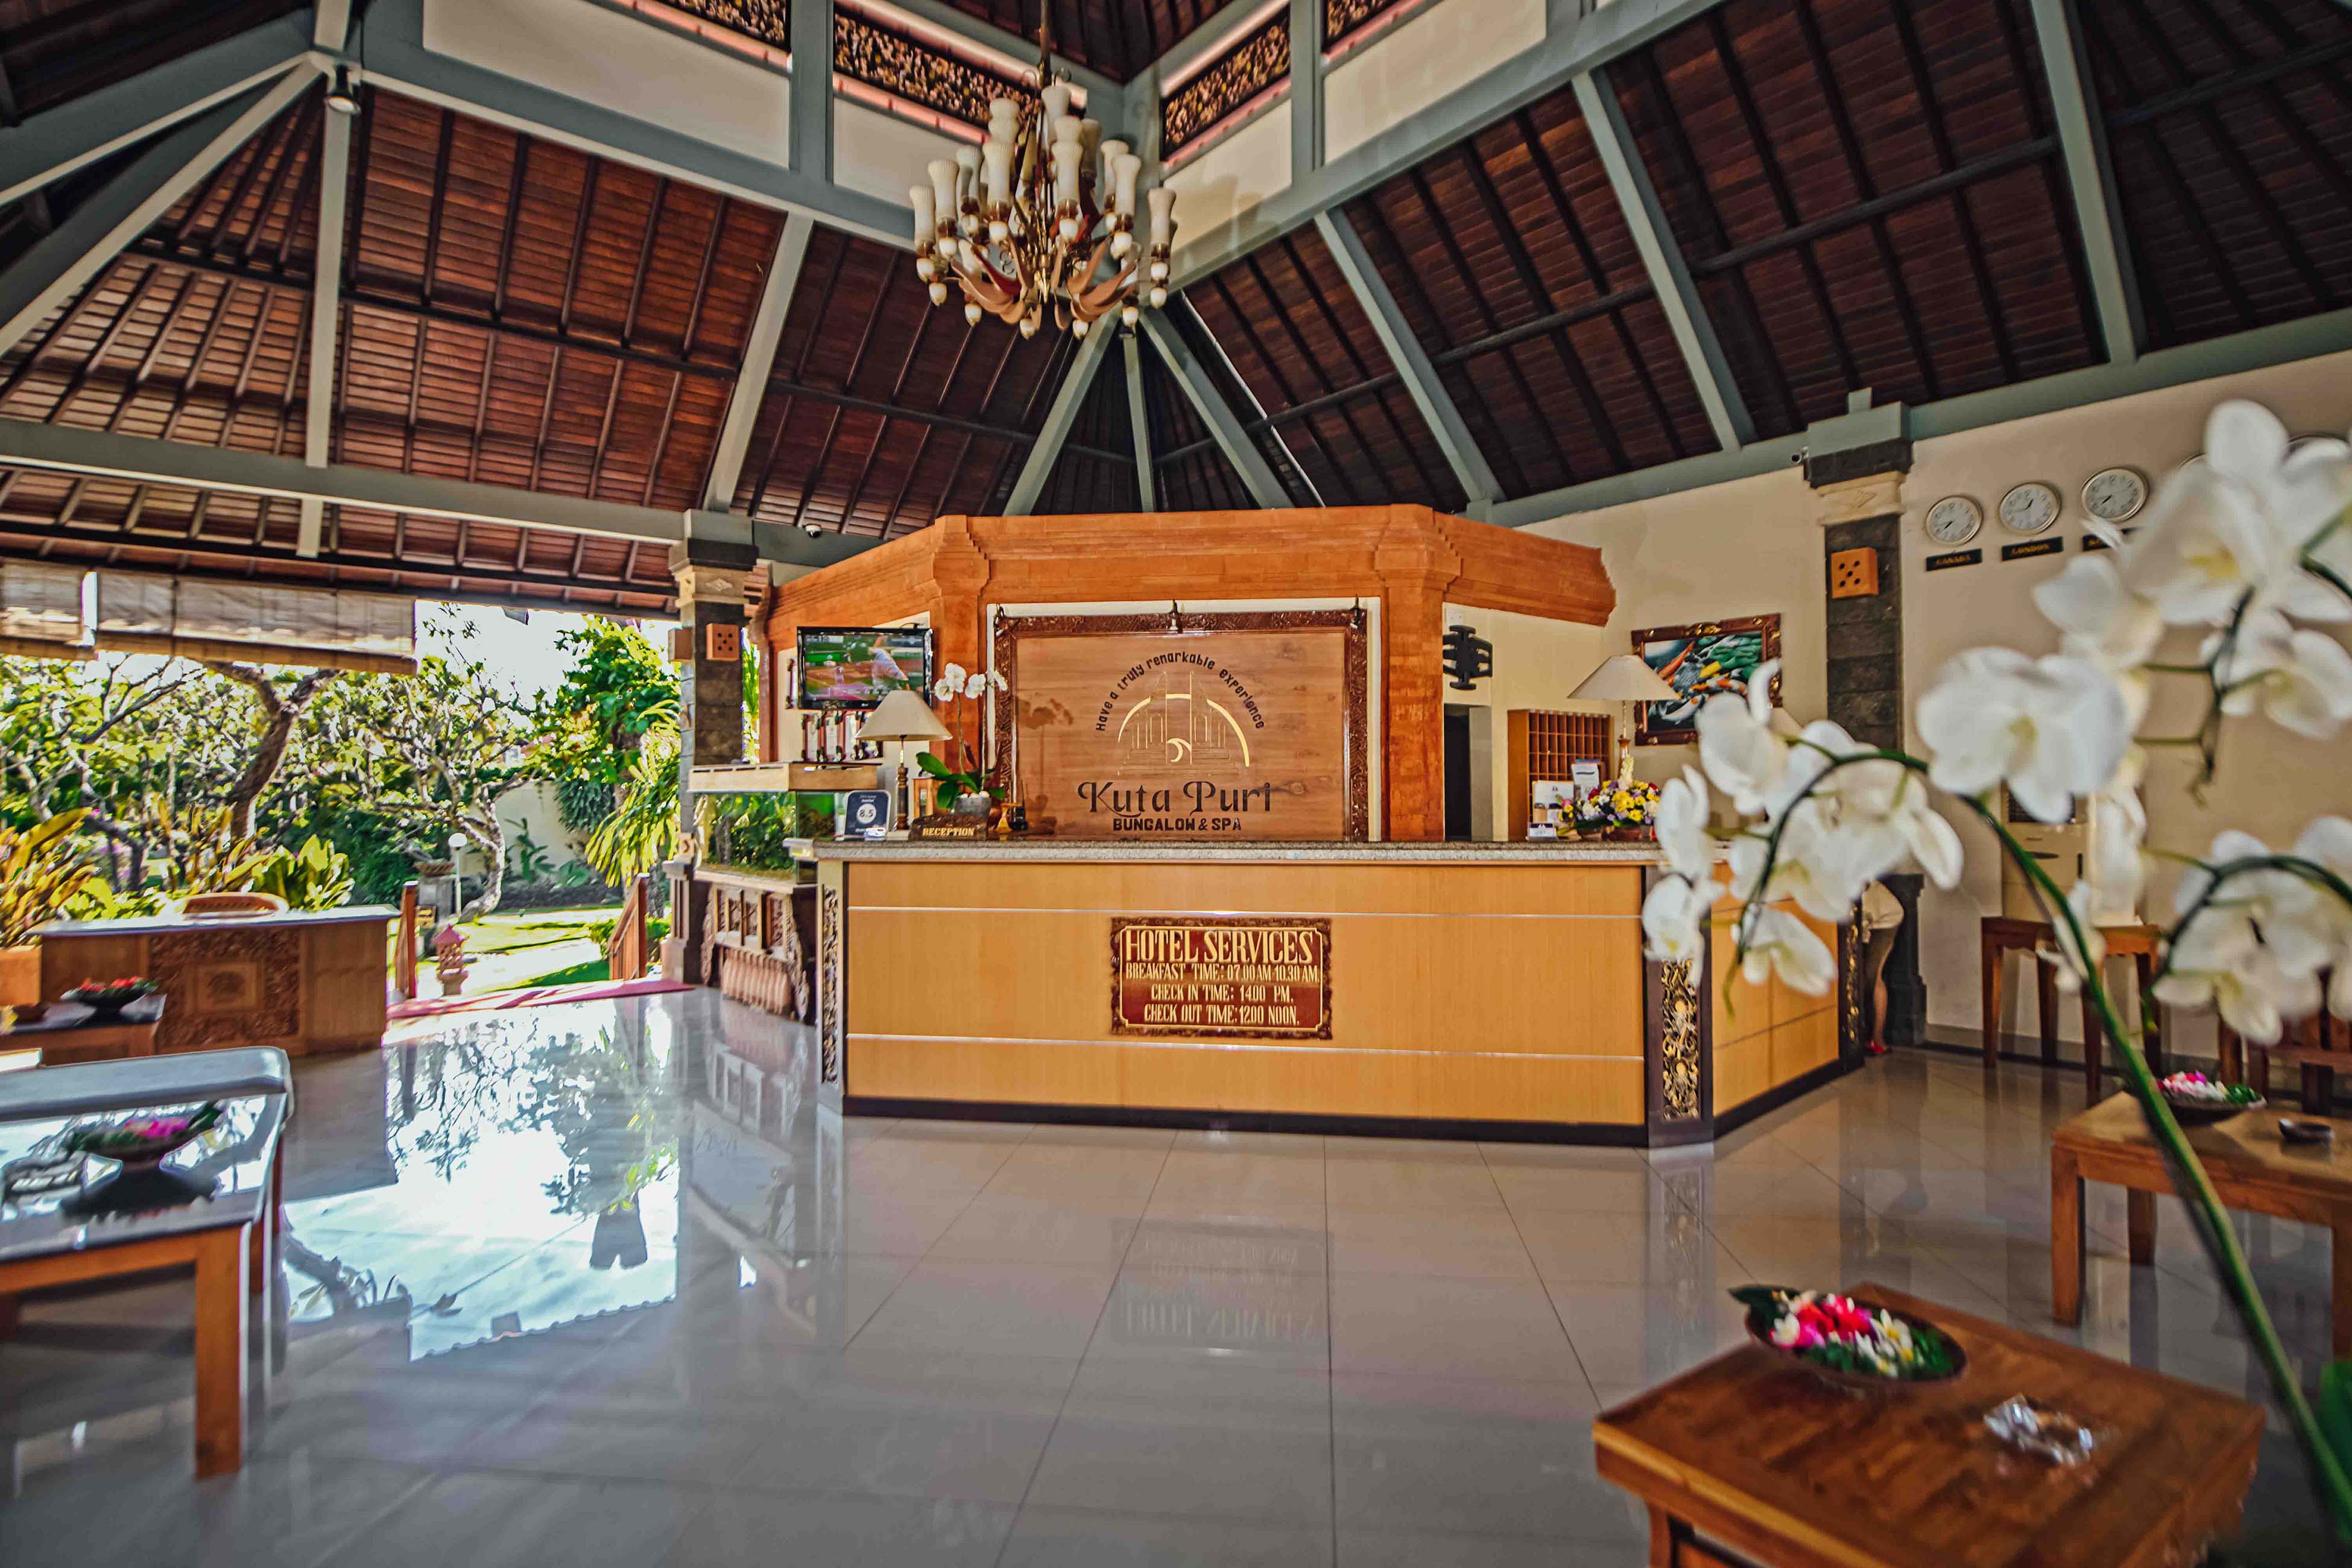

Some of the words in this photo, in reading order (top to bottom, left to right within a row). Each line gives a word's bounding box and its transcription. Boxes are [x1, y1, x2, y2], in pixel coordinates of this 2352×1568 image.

[1095, 701, 1113, 732] Have
[1110, 691, 1119, 700] a
[1117, 664, 1145, 691] truly
[1078, 781, 1171, 818] Kuta
[1183, 780, 1271, 816] Puri
[922, 827, 975, 836] RECEPTION
[1113, 817, 1195, 832] BUNGALOW
[1198, 818, 1208, 831] &
[1211, 818, 1242, 831] SPA
[1125, 929, 1199, 963] HOTEL
[1204, 930, 1314, 964] SERVICES
[1125, 962, 1186, 981] BREAKFAST
[1191, 963, 1224, 981] TIME:
[1151, 984, 1184, 1001] CHECK
[1187, 984, 1199, 1002] IN
[1202, 984, 1234, 1002] TIME:
[1143, 1004, 1177, 1022] CHECK
[1181, 1004, 1203, 1023] OUT
[1206, 1004, 1238, 1025] TIME:
